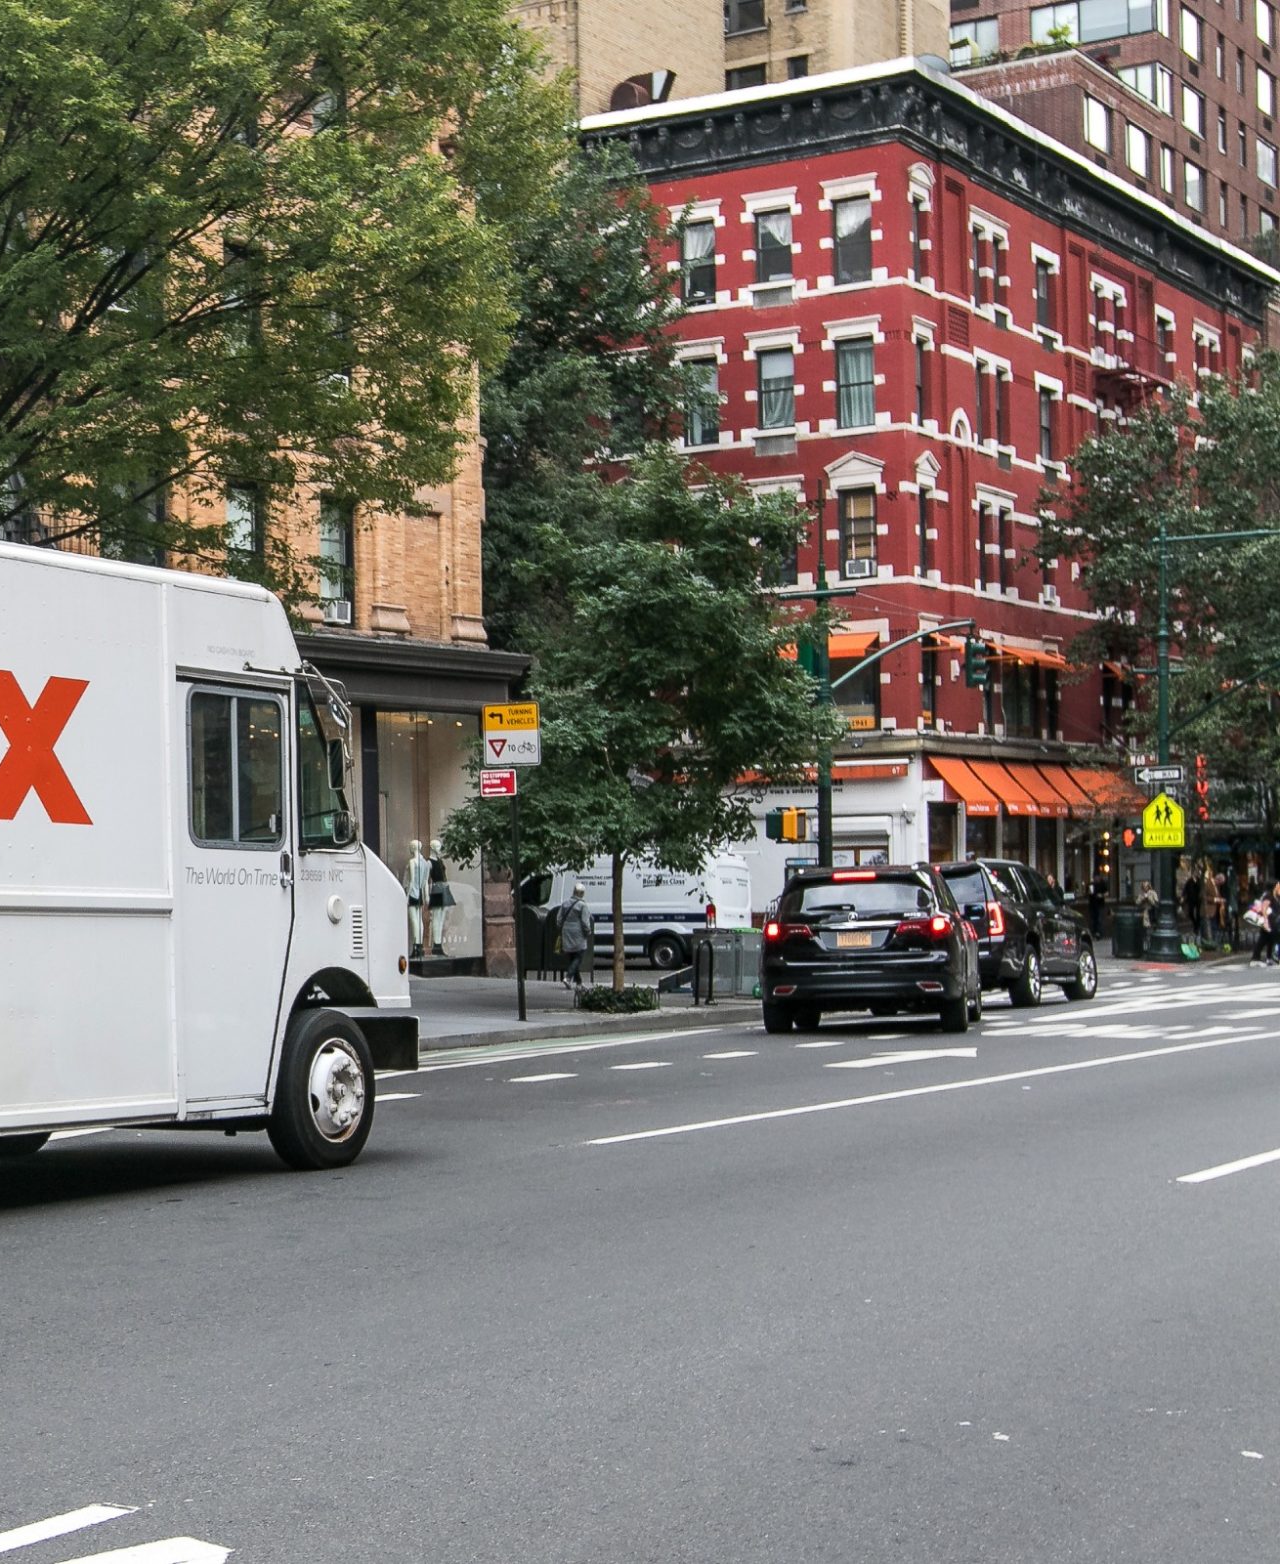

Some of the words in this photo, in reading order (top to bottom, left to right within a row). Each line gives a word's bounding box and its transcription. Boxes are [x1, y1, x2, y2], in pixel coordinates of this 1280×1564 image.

[507, 717, 535, 725] VEHICLES
[508, 744, 517, 752] TO
[185, 866, 204, 885] The
[206, 867, 236, 885] World
[238, 867, 253, 886] On
[254, 868, 279, 886] Time
[328, 869, 344, 882] NYC
